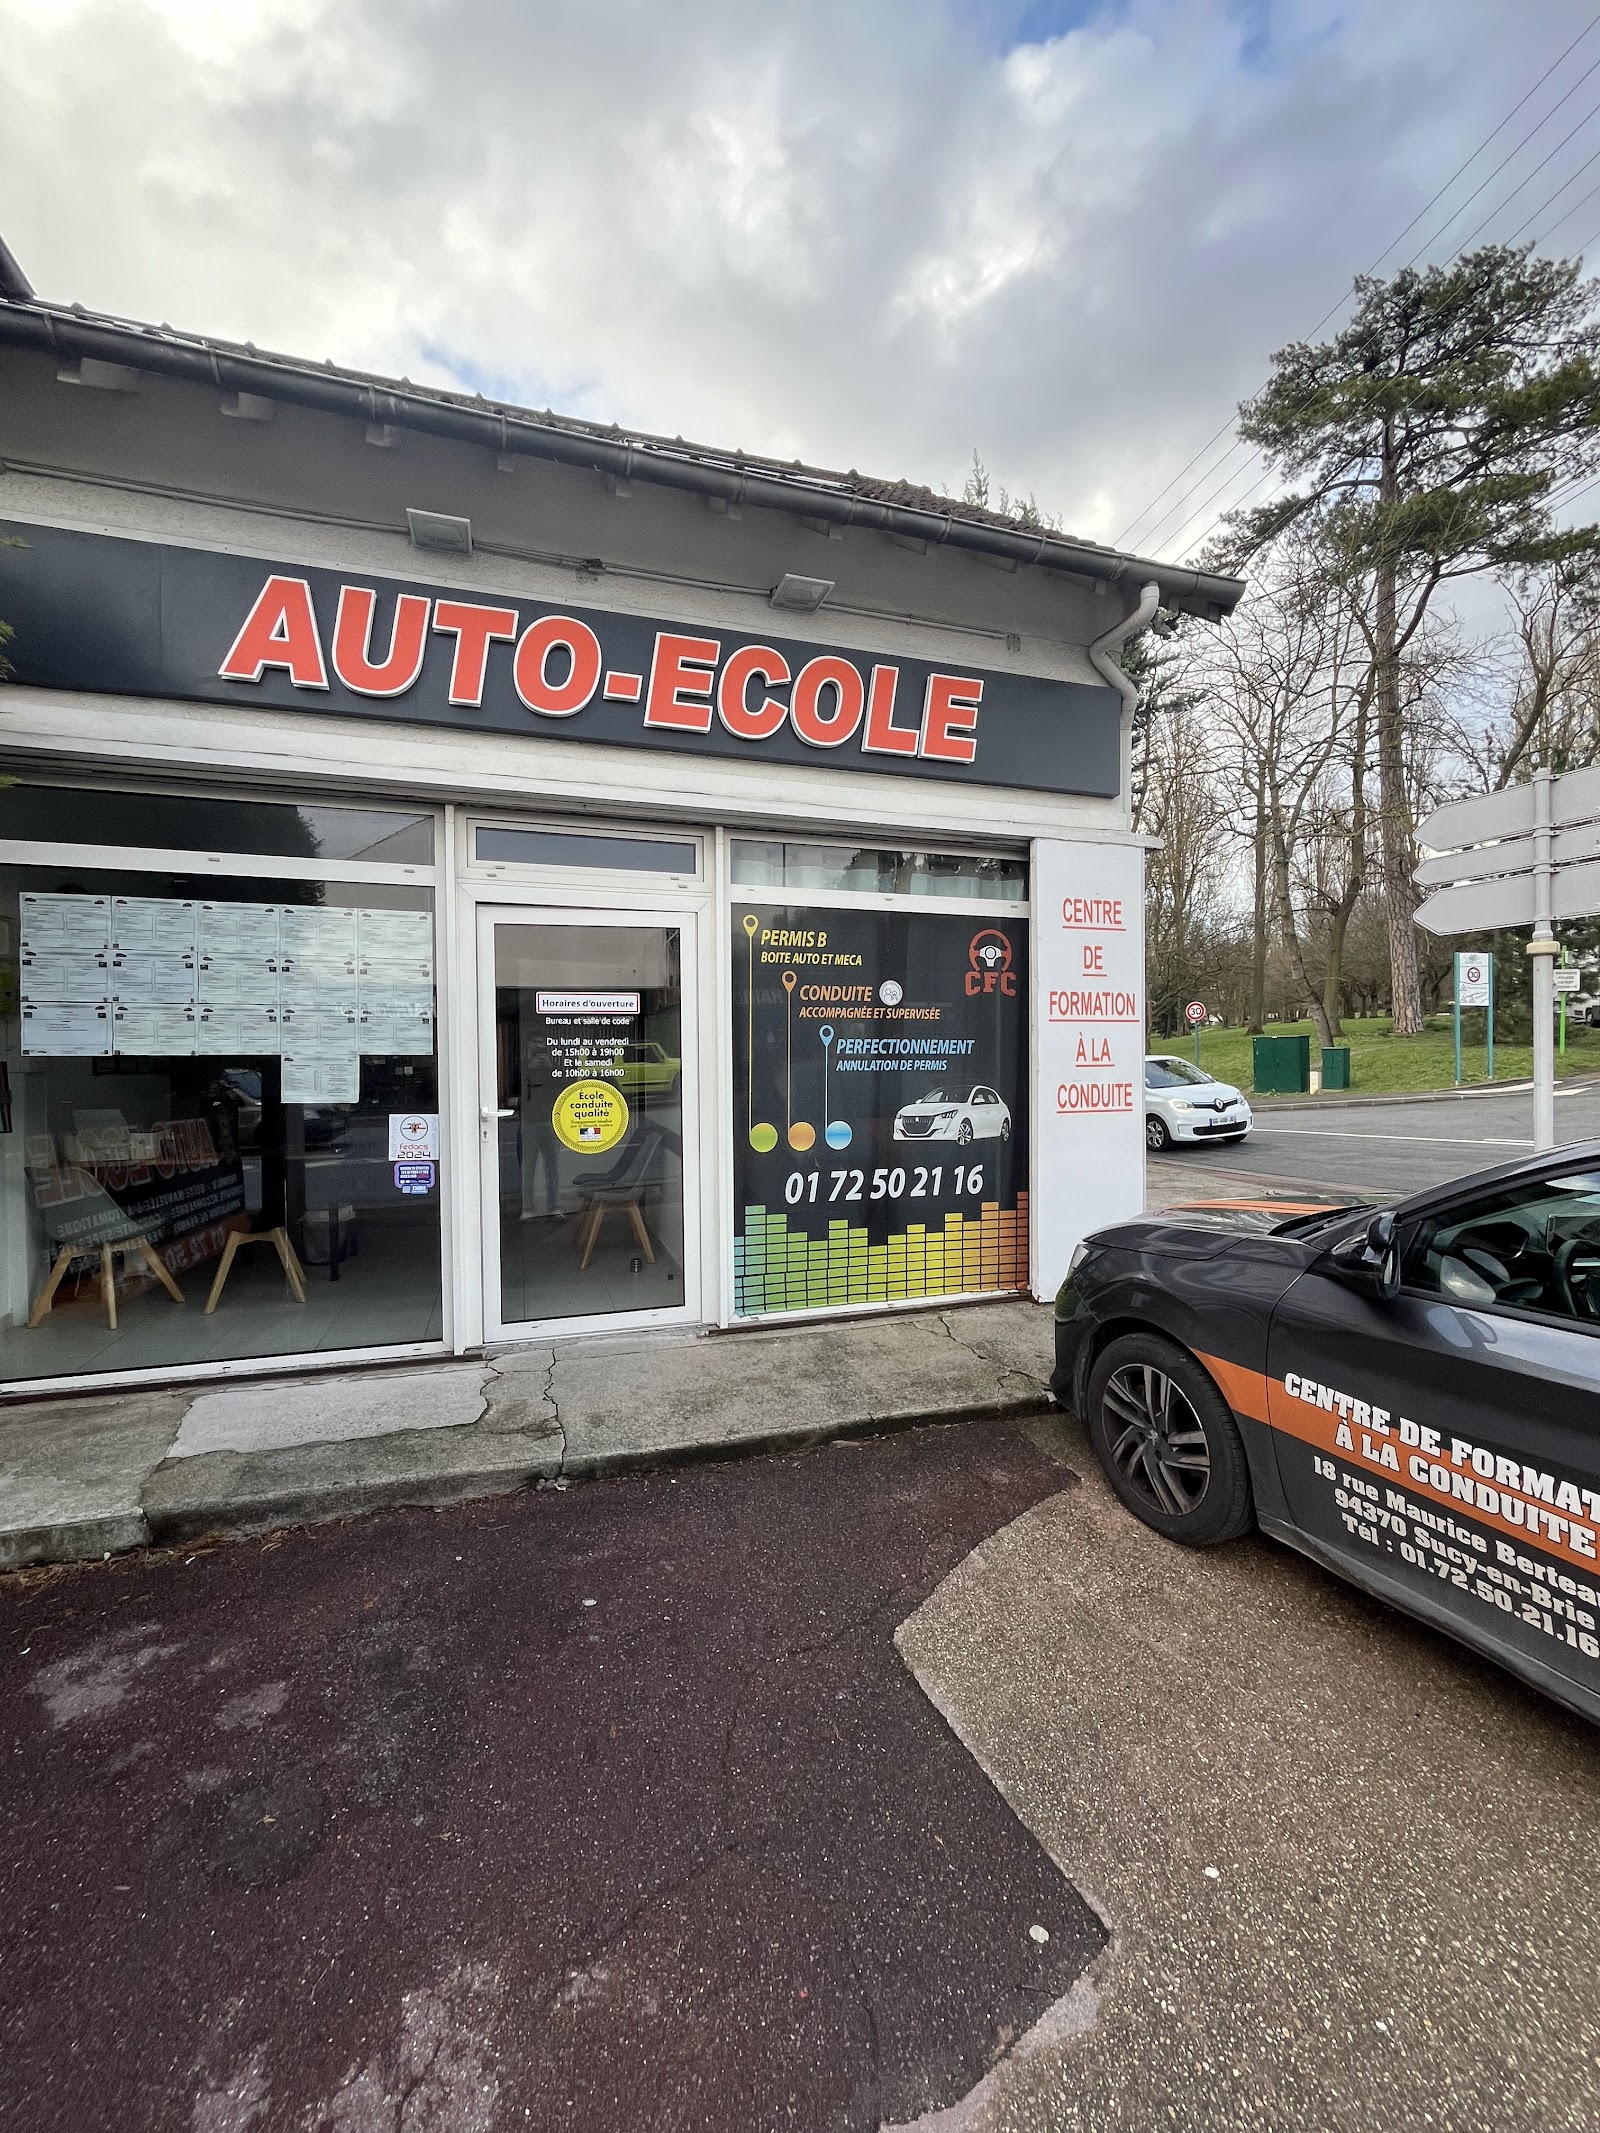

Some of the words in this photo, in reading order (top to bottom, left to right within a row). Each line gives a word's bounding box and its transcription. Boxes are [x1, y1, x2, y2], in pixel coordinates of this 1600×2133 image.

[218, 575, 984, 764] AUTO-ECOLE
[1062, 897, 1122, 925] CENTRE
[760, 929, 815, 947] PERMIS
[817, 932, 827, 947] B
[760, 952, 791, 965] BOITE
[792, 953, 821, 965] AUTO
[822, 954, 833, 965] ET
[834, 954, 863, 966] MECA
[1083, 945, 1103, 970] DE
[799, 984, 873, 1002] CONDUITE
[964, 971, 1017, 997] CFC
[542, 998, 580, 1008] Horaires
[582, 998, 635, 1008] d'ouverture
[1049, 991, 1136, 1016] FORMATION
[1190, 1007, 1202, 1016] 30
[545, 1017, 572, 1025] Bureau
[573, 1017, 582, 1025] et
[582, 1017, 600, 1025] salle
[601, 1017, 611, 1025] de
[612, 1017, 630, 1025] code
[799, 1005, 873, 1019] ACCOMPAGNÉE
[873, 1007, 885, 1019] ET
[886, 1006, 941, 1020] SUPERVISÉE
[546, 1037, 559, 1046] Du
[560, 1037, 581, 1046] lundi
[594, 1037, 629, 1046] vendredi
[836, 1038, 975, 1055] PERFECTIONNEMENT
[1076, 1031, 1087, 1062] À
[1091, 1037, 1111, 1062] LA
[551, 1048, 562, 1056] de
[564, 1048, 590, 1056] 15h00
[592, 1048, 598, 1056] à
[599, 1048, 625, 1056] 19h00
[564, 1059, 572, 1067] Et
[574, 1059, 582, 1067] le
[584, 1059, 613, 1067] samedi
[836, 1060, 899, 1071] ANNULATION
[900, 1060, 912, 1071] DE
[912, 1060, 948, 1072] PERMIS
[551, 1069, 562, 1077] de
[565, 1069, 590, 1077] 10h00
[592, 1069, 598, 1077] à
[600, 1069, 625, 1077] 16h00
[579, 1089, 604, 1100] École
[1057, 1083, 1133, 1109] CONDUITE
[570, 1100, 614, 1110] conduite
[574, 1109, 610, 1120] qualité
[785, 1171, 820, 1205] 01
[828, 1169, 865, 1202] 72
[869, 1167, 906, 1200] 50
[909, 1166, 943, 1198] 21
[953, 1164, 984, 1196] 16
[1284, 1372, 1391, 1436] CENTRE
[1399, 1416, 1442, 1458] DE
[1335, 1419, 1354, 1452] À
[1361, 1433, 1400, 1472] LA
[1408, 1455, 1596, 1559] CONDUITE
[1313, 1455, 1337, 1482] 18
[1342, 1471, 1379, 1501] rue
[1386, 1489, 1488, 1553] Maurice
[1334, 1488, 1408, 1538] 94370
[1413, 1526, 1596, 1631] Sucy-en-Brie
[1341, 1512, 1380, 1546] Tél
[1386, 1539, 1394, 1553] :
[1400, 1547, 1600, 1660] 01.72.50.21.16
